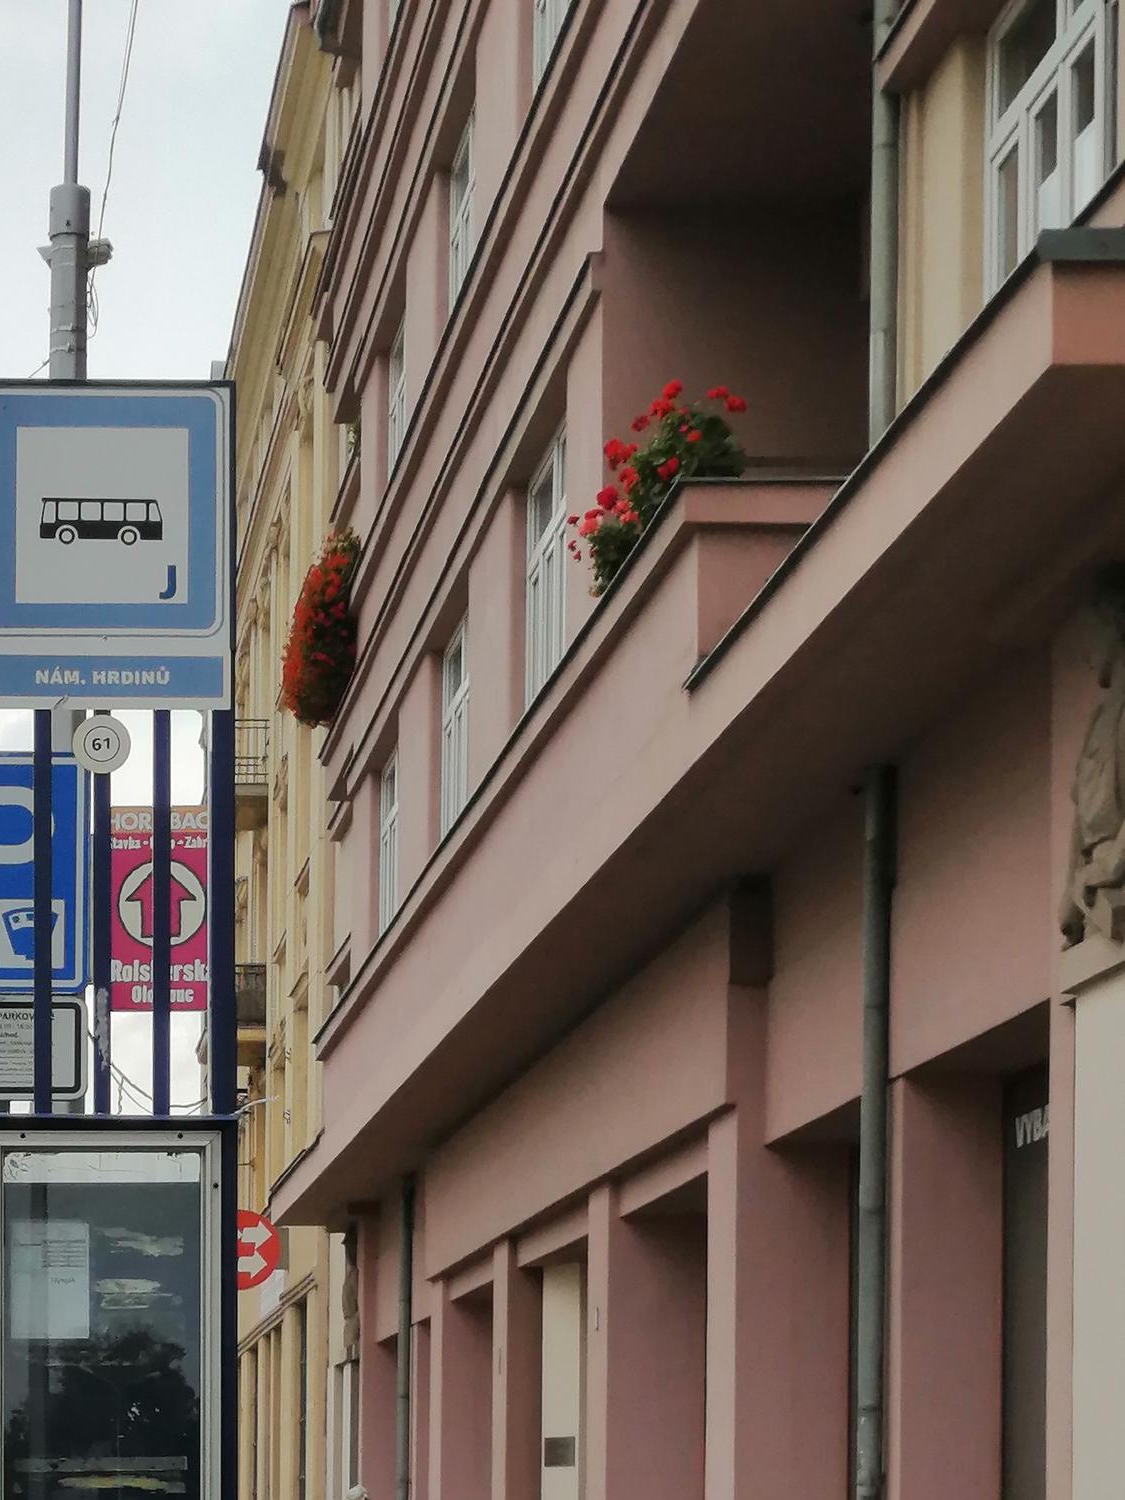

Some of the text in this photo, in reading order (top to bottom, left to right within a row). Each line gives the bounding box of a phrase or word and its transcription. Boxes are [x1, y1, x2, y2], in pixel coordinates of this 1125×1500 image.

[35, 666, 171, 685] NÁM. HRDINŮ
[92, 737, 110, 751] 61
[111, 812, 208, 831] HORBAC
